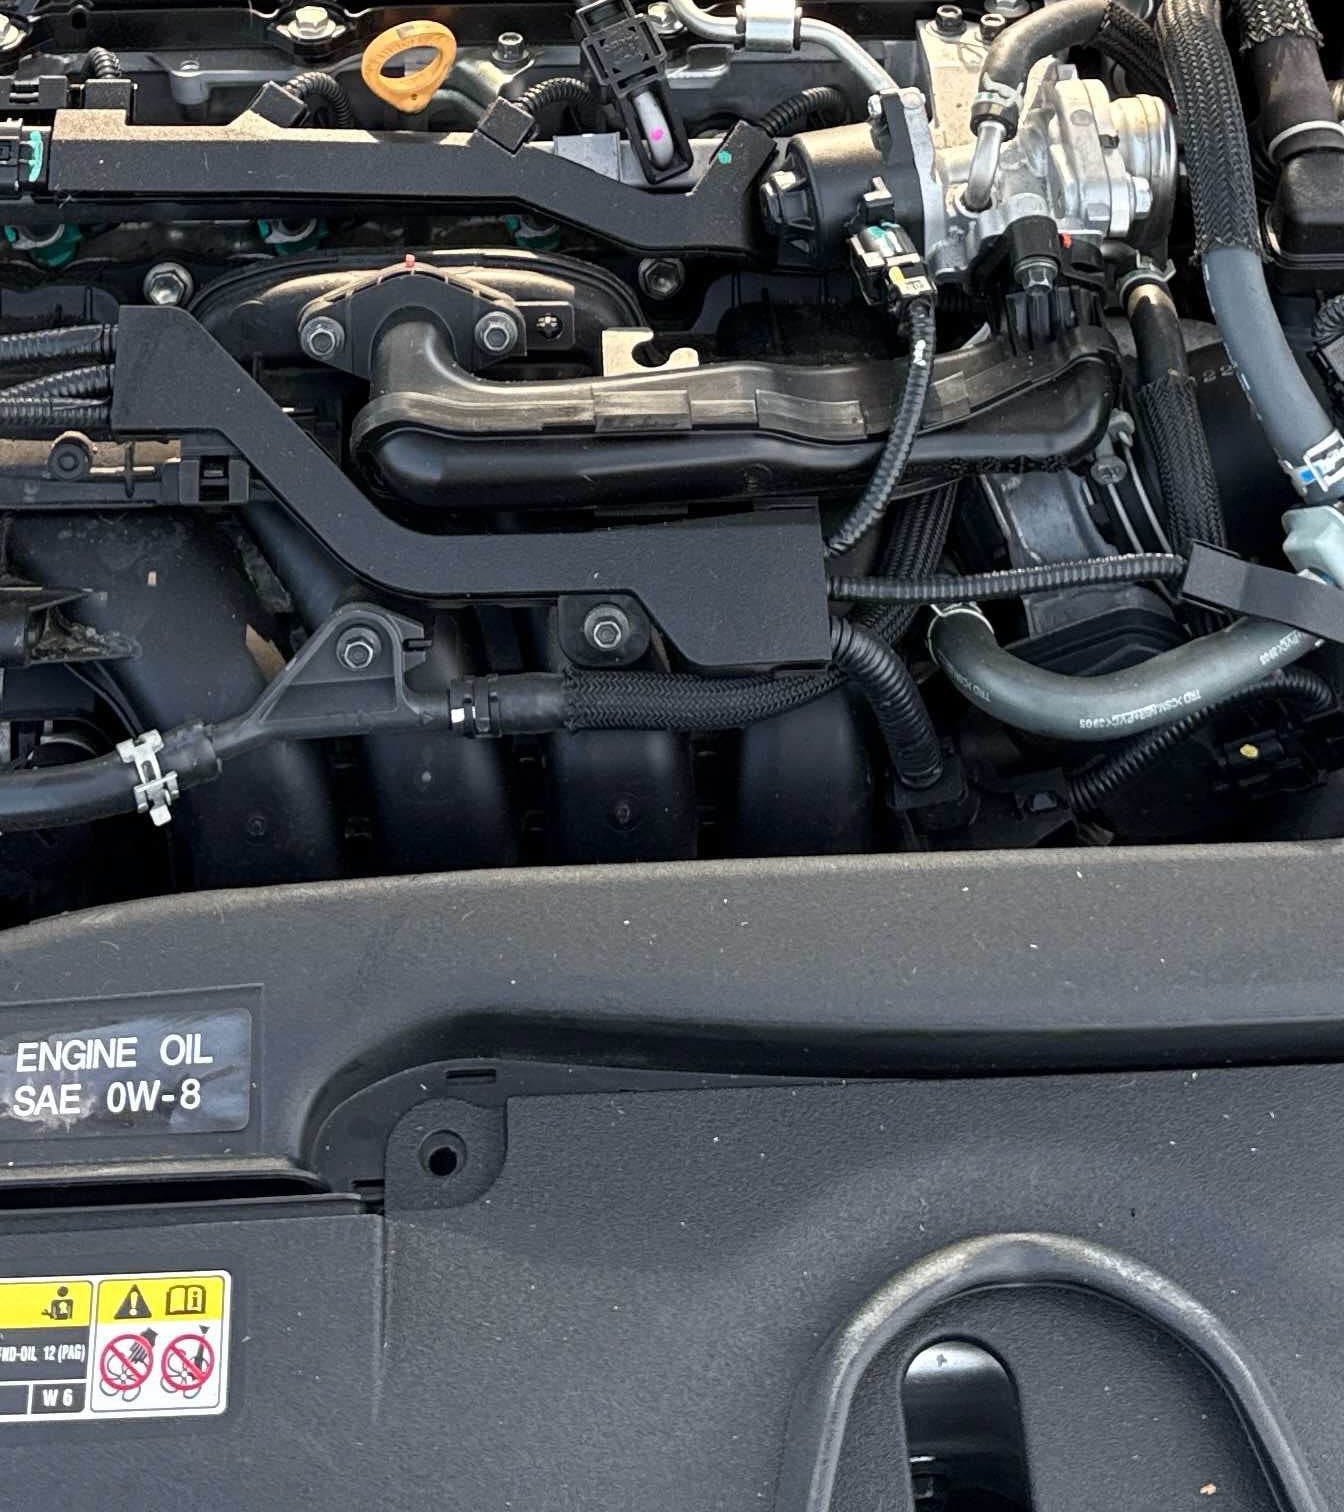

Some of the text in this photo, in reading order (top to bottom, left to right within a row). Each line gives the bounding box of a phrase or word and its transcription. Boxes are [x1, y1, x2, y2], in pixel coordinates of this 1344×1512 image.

[15, 1034, 214, 1073] ENGINE OIL
[12, 1078, 202, 1117] SAE 0W-8
[43, 1345, 57, 1361] 12
[58, 1344, 86, 1364] (PAG)
[42, 1388, 73, 1407] W 6
